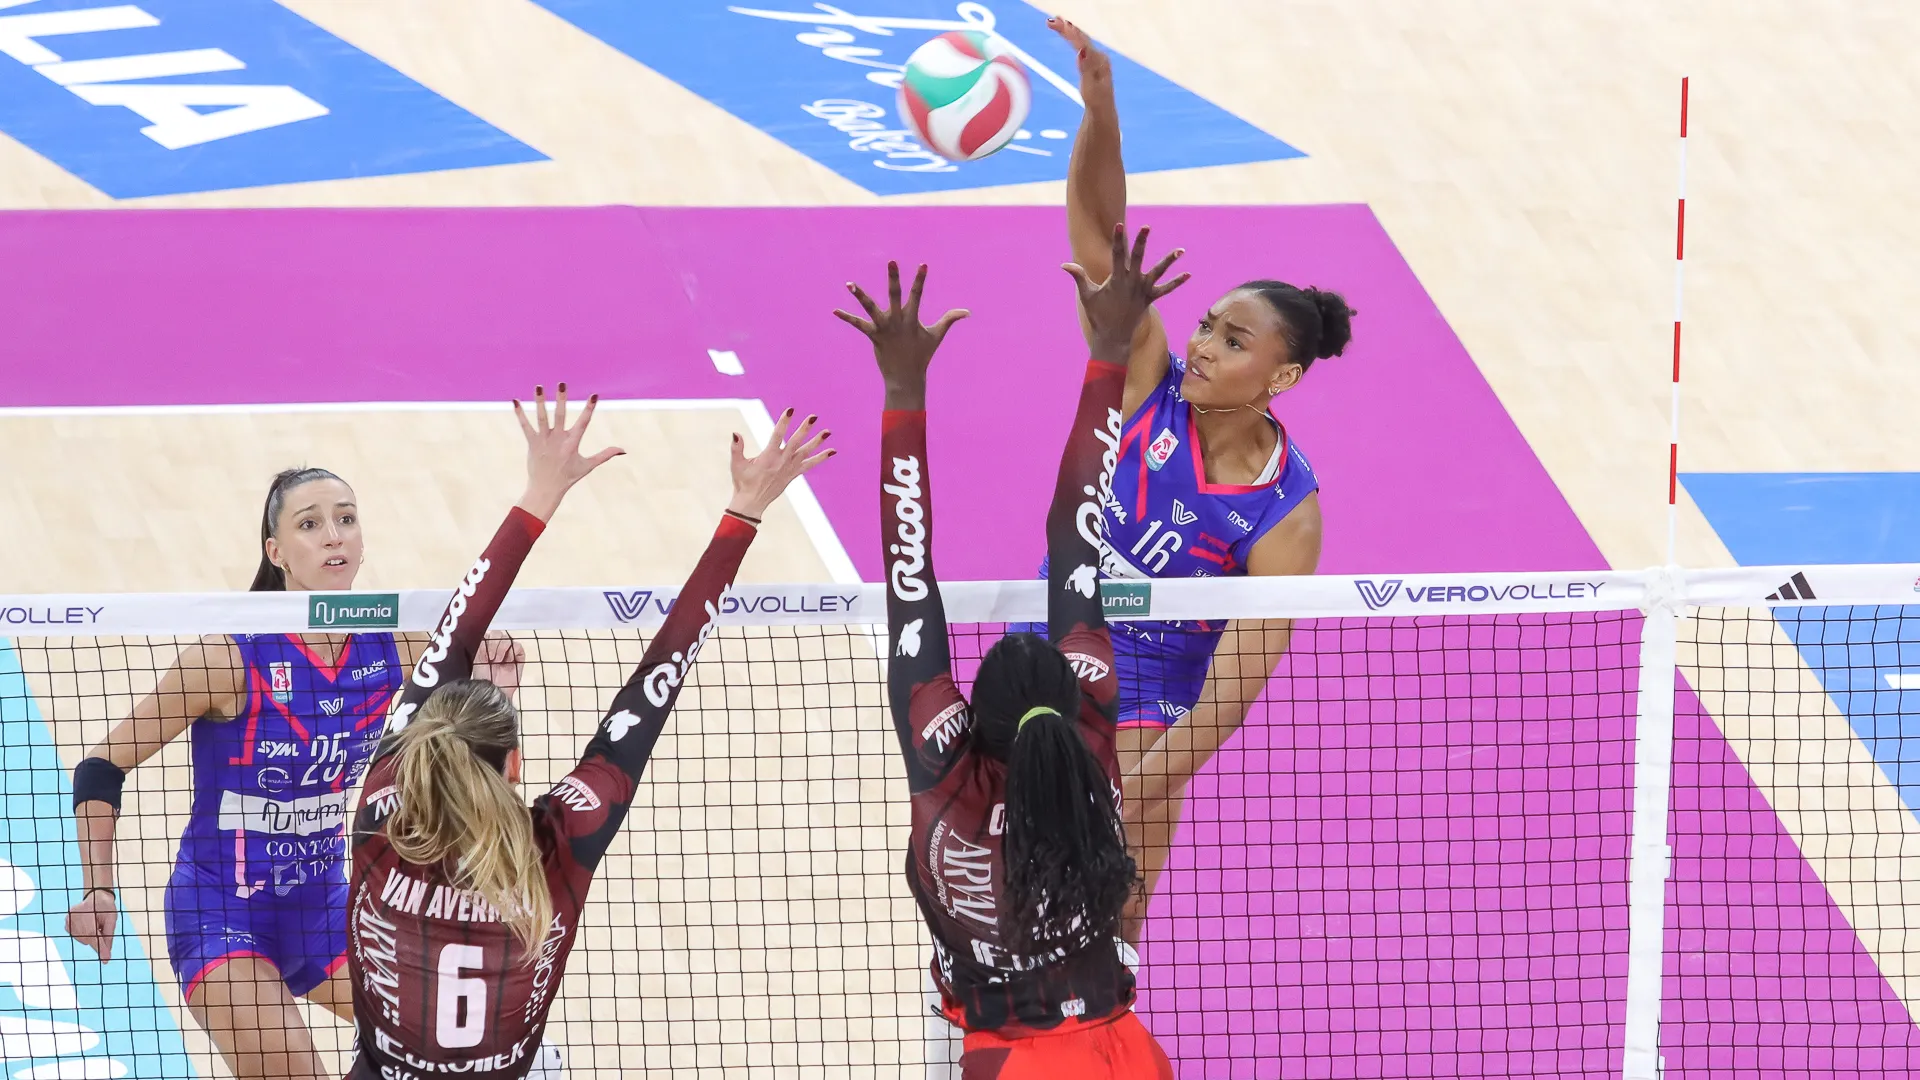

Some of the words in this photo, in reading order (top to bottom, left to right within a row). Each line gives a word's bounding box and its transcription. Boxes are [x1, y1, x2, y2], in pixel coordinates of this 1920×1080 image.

[0, 0, 330, 150] LIA
[883, 455, 929, 602] Ricola
[1130, 519, 1183, 574] 16
[339, 604, 392, 619] numia
[655, 594, 859, 616] VOVOLLEY
[1101, 592, 1144, 607] umia
[1405, 581, 1606, 603] VEROVOLLEY
[412, 556, 491, 688] Ricola
[257, 740, 300, 759] SYM
[300, 731, 351, 785] 25
[380, 867, 429, 916] VAN
[436, 943, 488, 1049] 6
